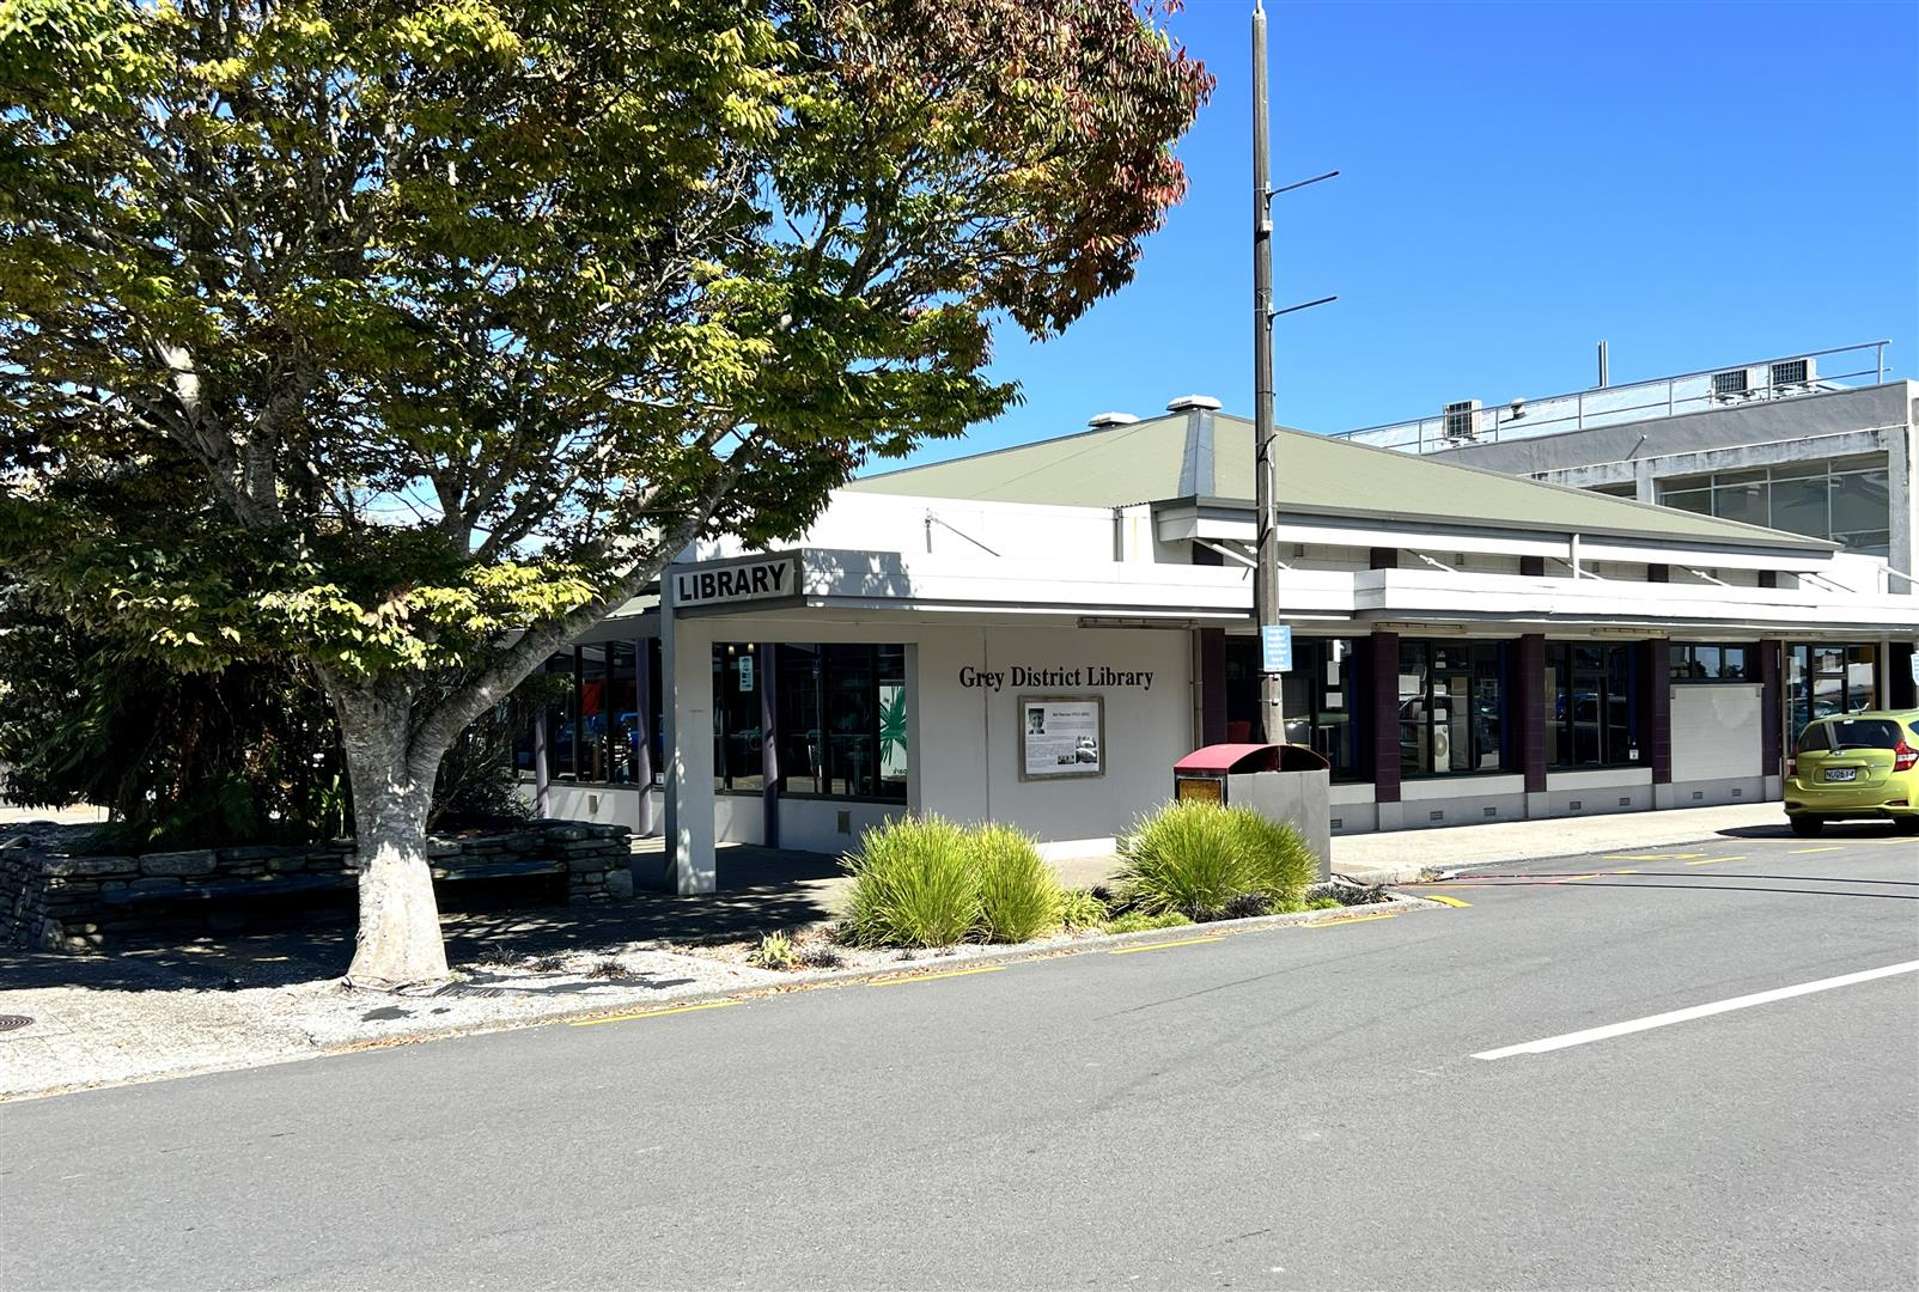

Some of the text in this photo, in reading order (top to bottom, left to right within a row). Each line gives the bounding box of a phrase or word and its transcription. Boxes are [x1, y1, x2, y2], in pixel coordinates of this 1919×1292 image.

[679, 563, 786, 601] LIBRARY
[959, 666, 1154, 692] Grey District Library
